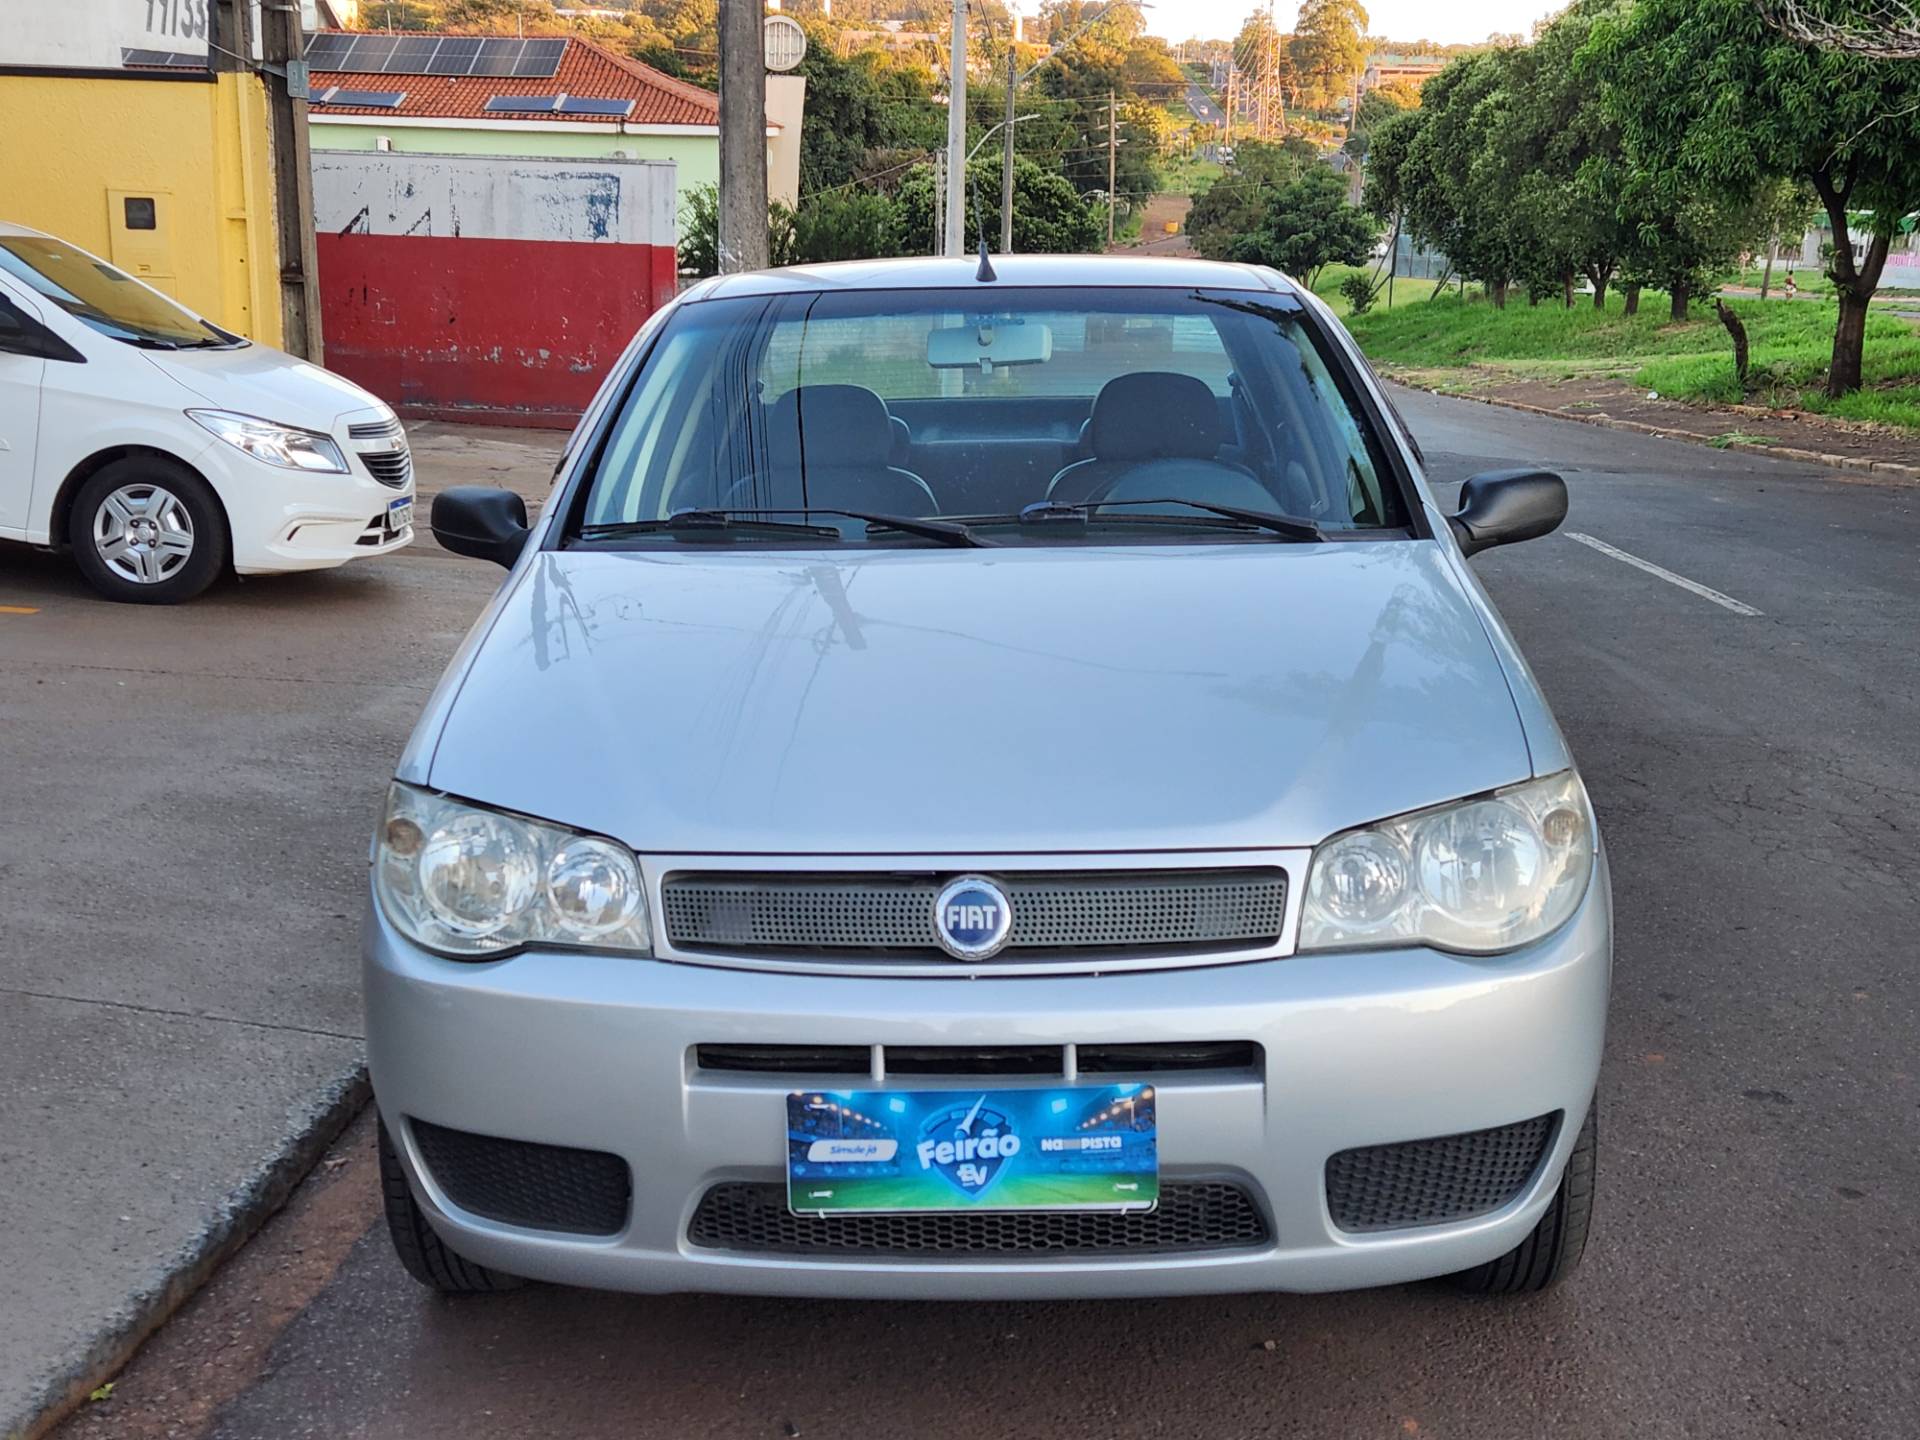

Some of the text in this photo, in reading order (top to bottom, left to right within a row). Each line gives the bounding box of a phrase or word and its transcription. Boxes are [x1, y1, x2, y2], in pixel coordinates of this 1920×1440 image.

[947, 905, 997, 930] FIAT
[830, 1145, 865, 1154] Simule
[916, 1127, 1021, 1170] Feirão
